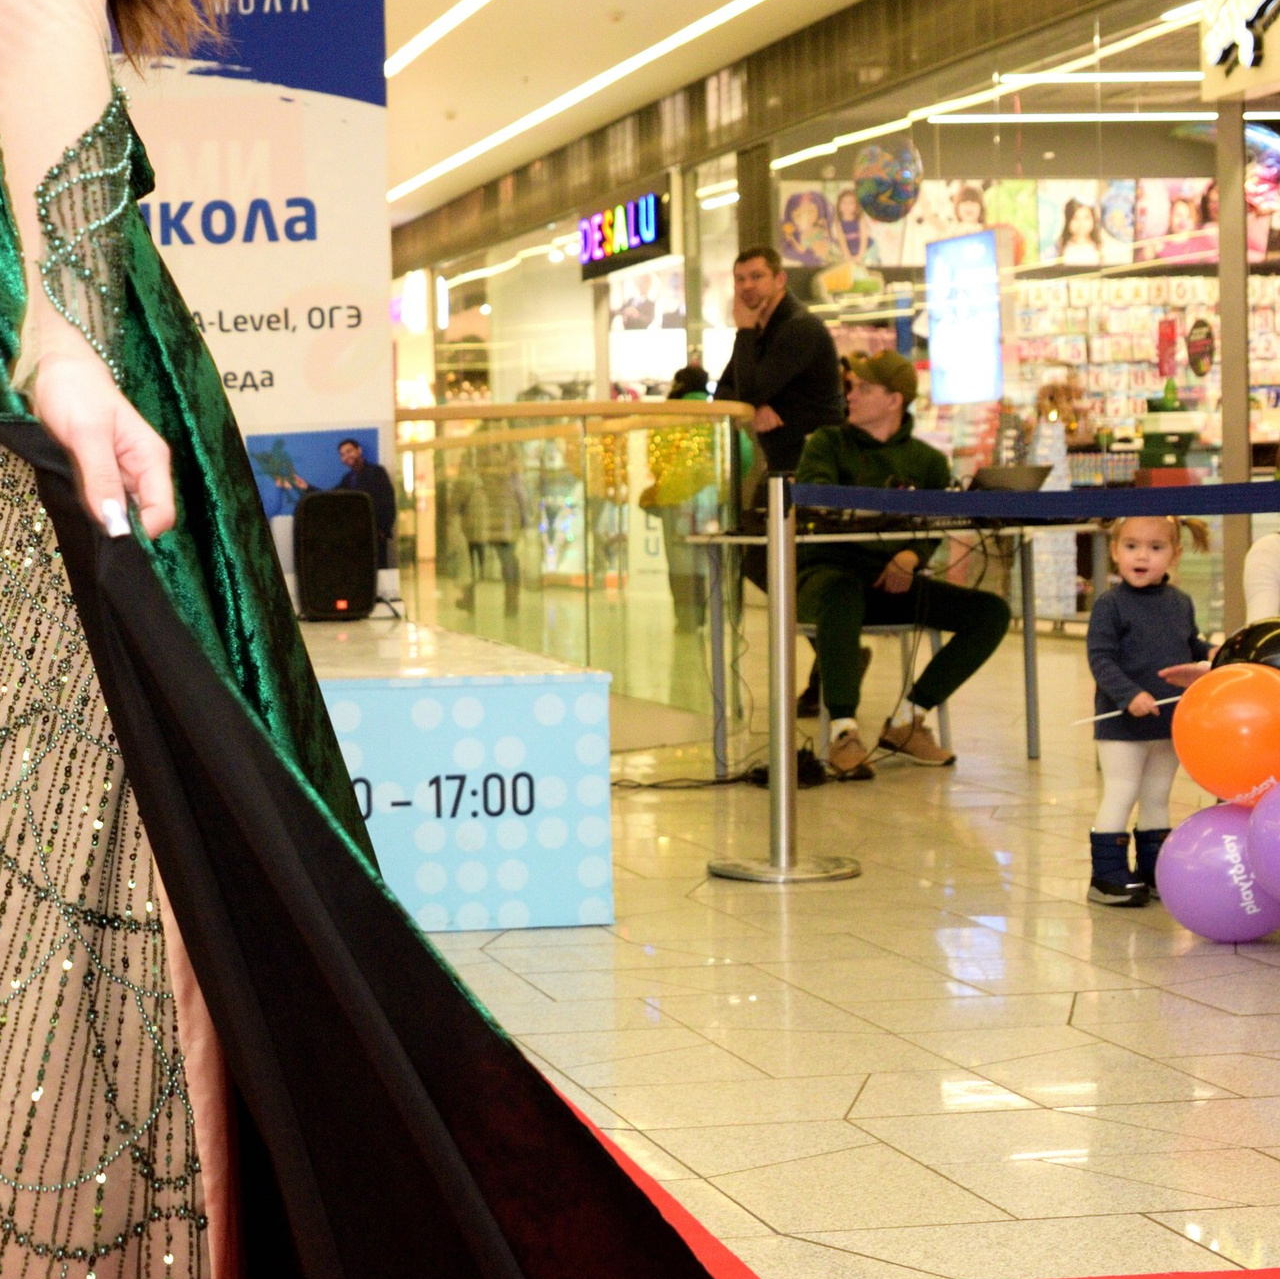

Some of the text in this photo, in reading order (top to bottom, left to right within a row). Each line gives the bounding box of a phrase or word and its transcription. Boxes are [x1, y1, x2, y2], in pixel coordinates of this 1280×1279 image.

[139, 197, 317, 246] кола
[578, 192, 657, 265] DESALU
[307, 305, 362, 330] ОГЭ
[222, 370, 275, 392] еда
[429, 772, 535, 819] 17:00
